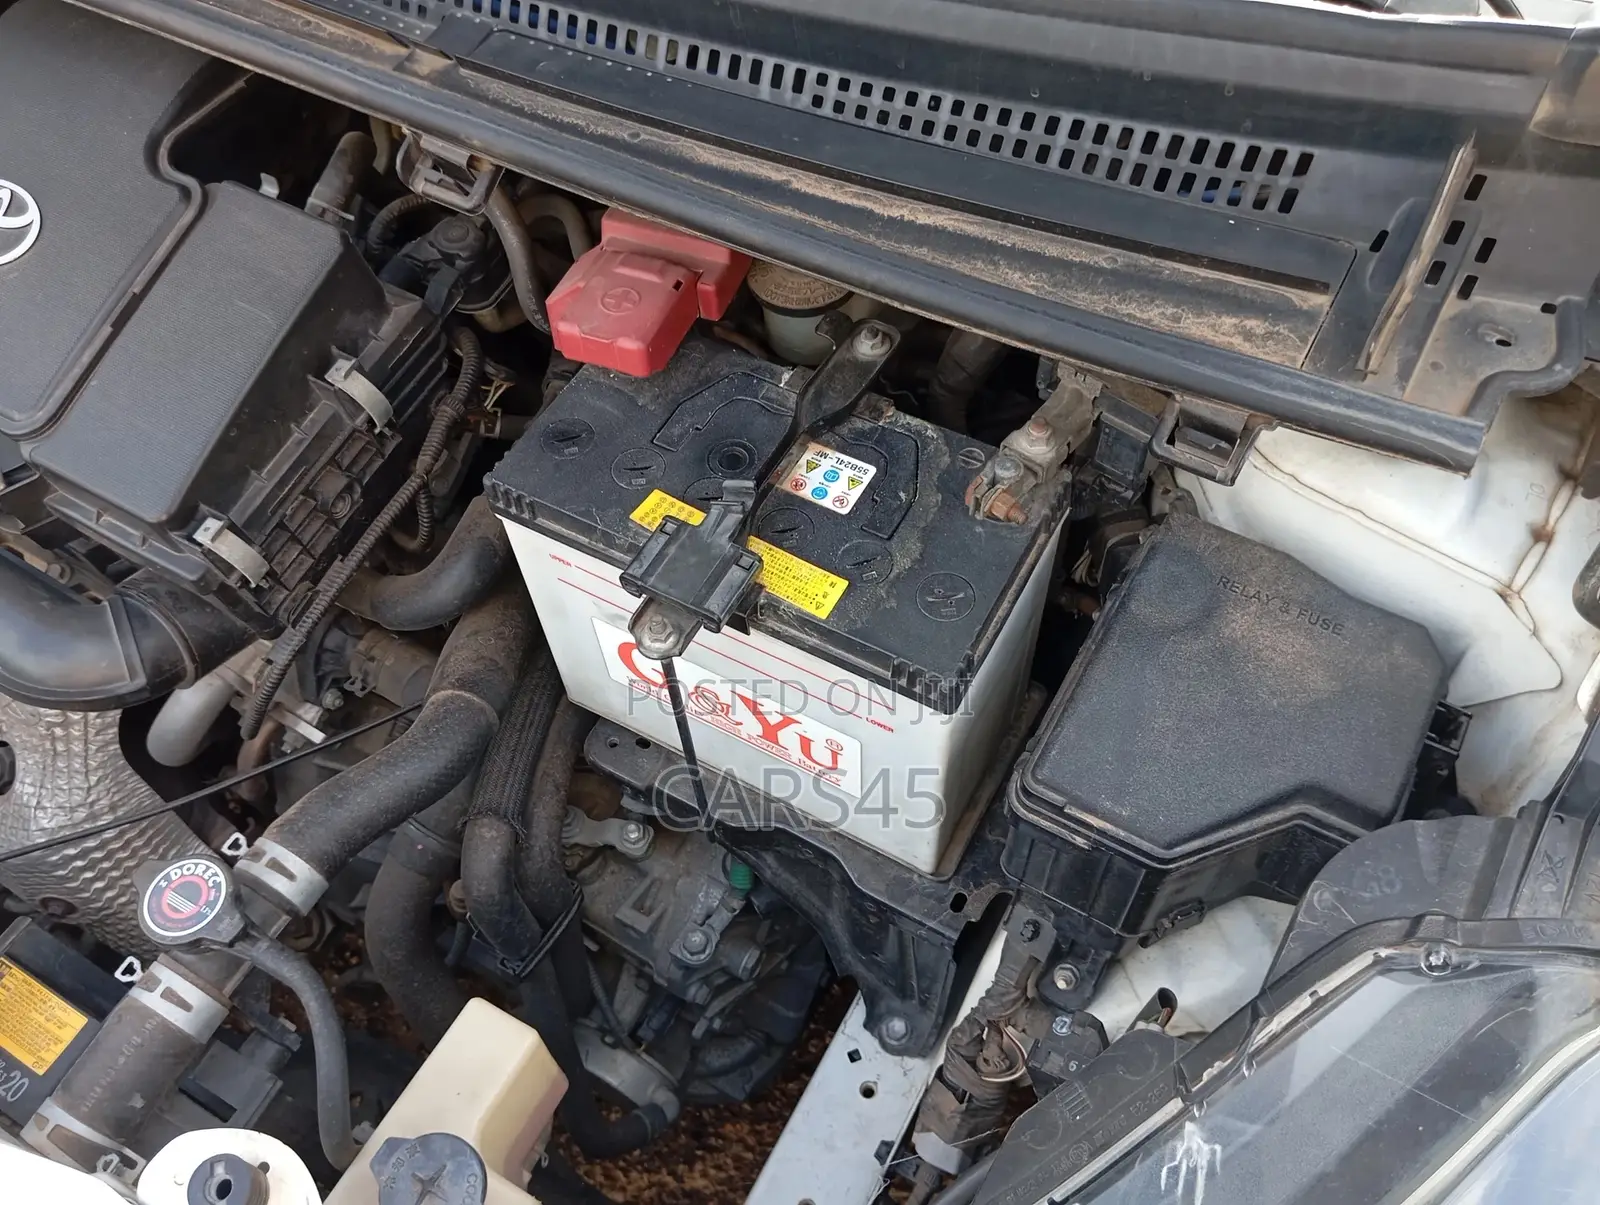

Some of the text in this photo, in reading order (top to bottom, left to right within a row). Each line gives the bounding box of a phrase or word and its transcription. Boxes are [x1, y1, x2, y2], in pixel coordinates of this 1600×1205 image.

[814, 450, 869, 476] 55B24L-MF
[1217, 575, 1346, 636] RELAY & FUSE
[865, 716, 895, 733] LOWER
